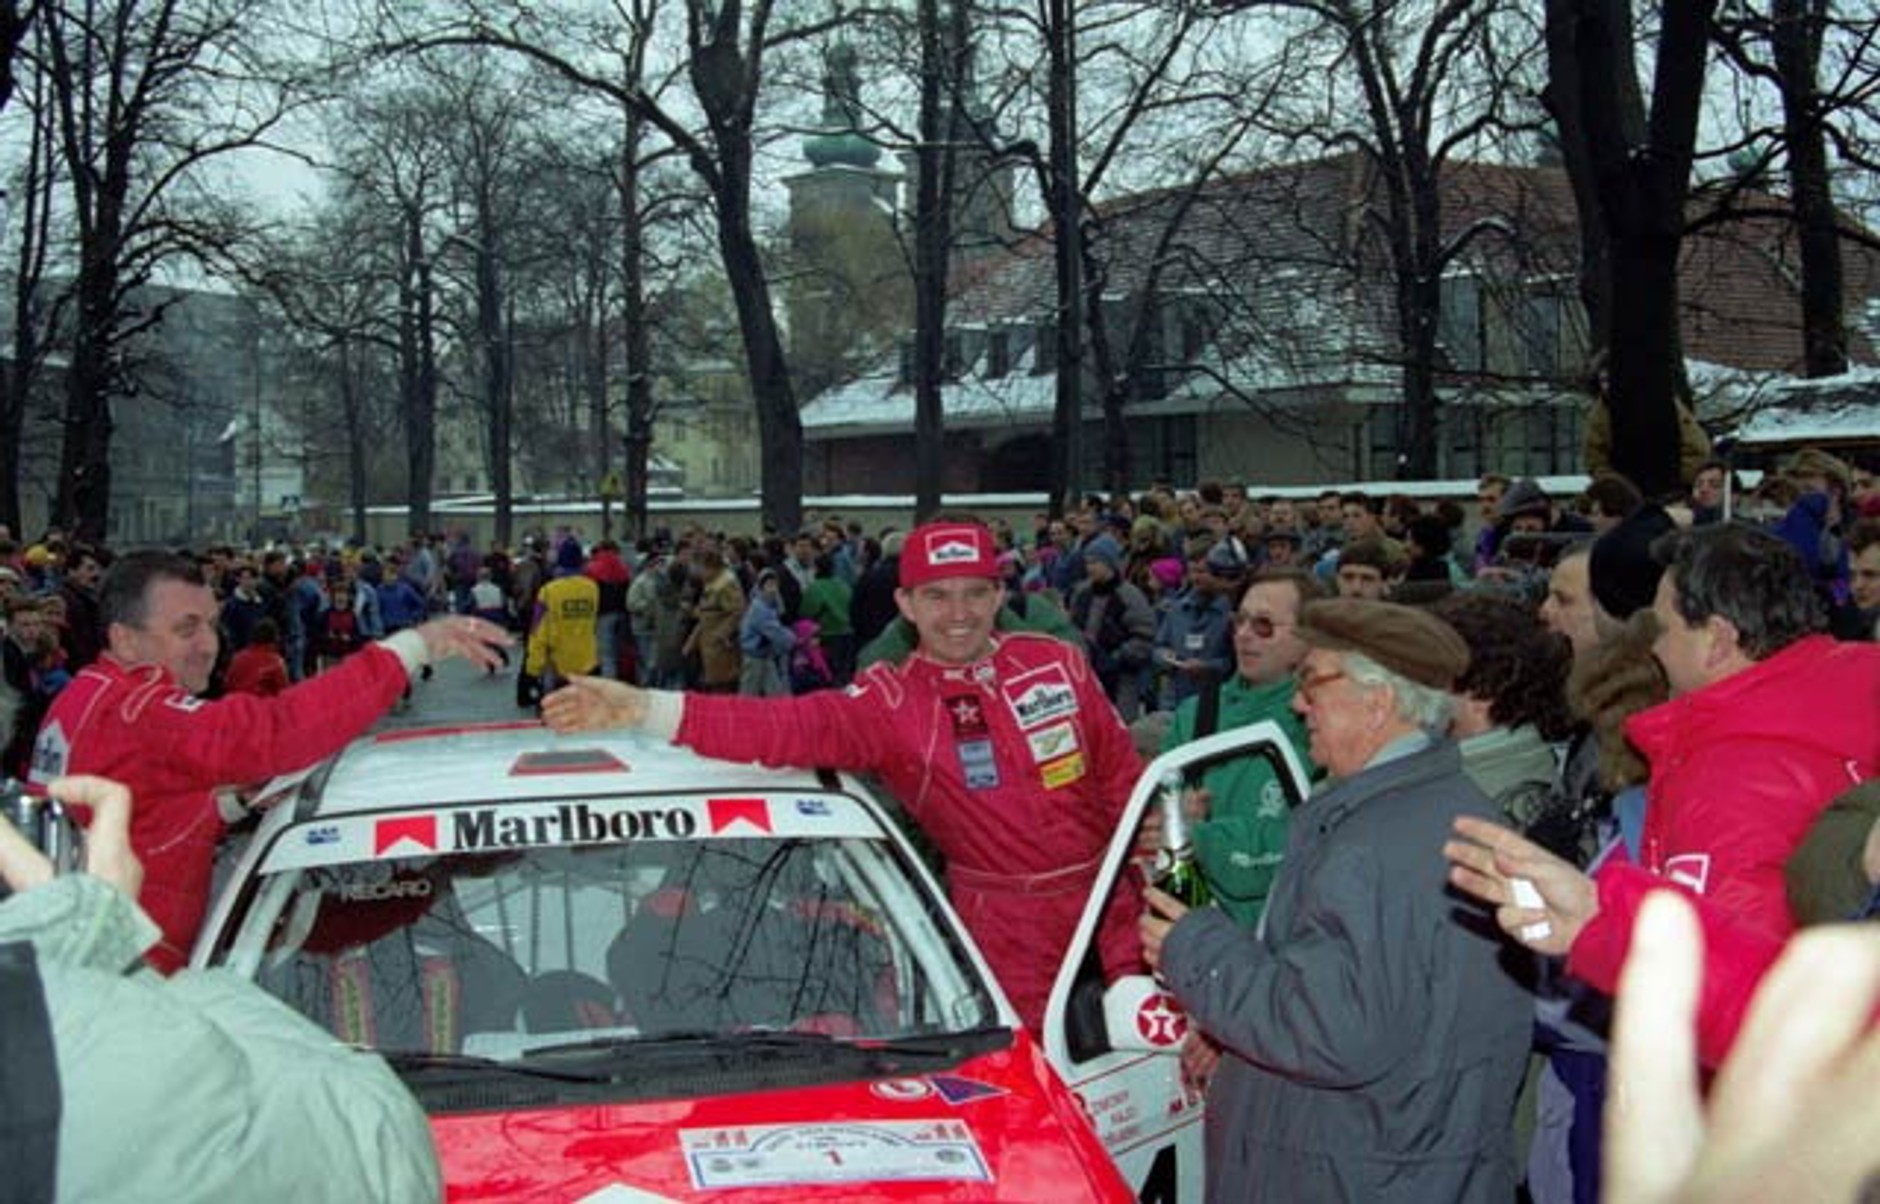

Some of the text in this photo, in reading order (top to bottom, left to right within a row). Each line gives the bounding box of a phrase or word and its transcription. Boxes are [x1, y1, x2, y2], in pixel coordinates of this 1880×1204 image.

[1015, 687, 1074, 718] Marlboro
[453, 804, 696, 850] Marlboro
[340, 880, 431, 903] RECARO
